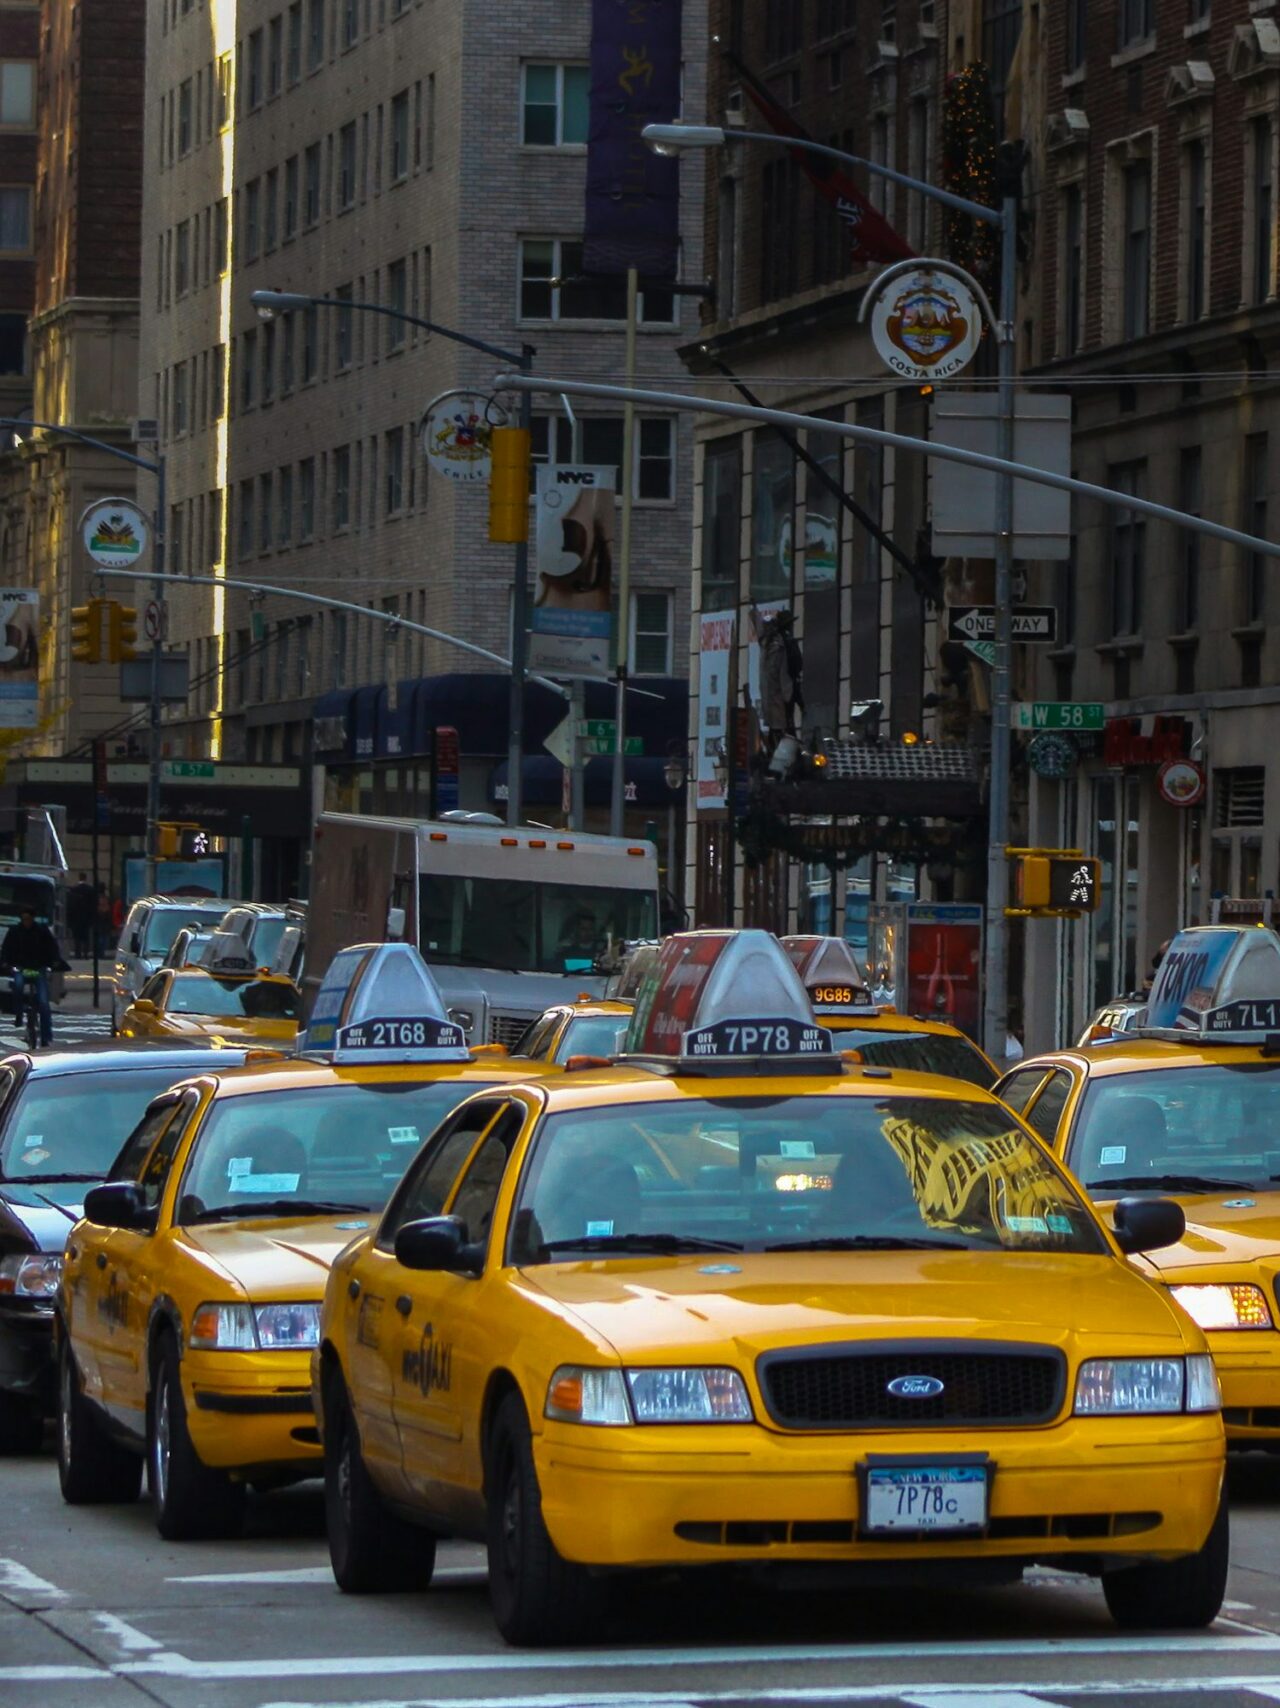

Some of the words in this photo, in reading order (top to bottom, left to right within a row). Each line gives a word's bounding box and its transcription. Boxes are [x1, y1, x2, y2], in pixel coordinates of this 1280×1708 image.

[889, 355, 929, 378] COSTA
[934, 357, 964, 377] RICA
[443, 468, 484, 480] CHILE
[557, 471, 594, 484] NYC
[3, 593, 27, 601] NYC
[965, 617, 995, 631] ONE
[1011, 617, 1042, 631] WAY
[1034, 706, 1050, 725] W
[1060, 705, 1083, 726] 58
[1089, 707, 1101, 717] ST
[174, 763, 182, 774] W
[188, 763, 202, 775] 57
[1156, 952, 1210, 1002] TOKYO
[815, 987, 851, 1003] 9G85
[1213, 1020, 1232, 1029] DUTY
[373, 1023, 425, 1045] 2T68
[697, 1033, 713, 1043] OFF
[725, 1026, 790, 1052] 7P78
[803, 1029, 819, 1040] OFF
[347, 1037, 367, 1046] DUTY
[437, 1036, 457, 1045] DUTY
[800, 1040, 824, 1051] DUTY
[693, 1043, 717, 1054] DUTY
[902, 1379, 931, 1393] Ford
[918, 1517, 937, 1525] TAXI
